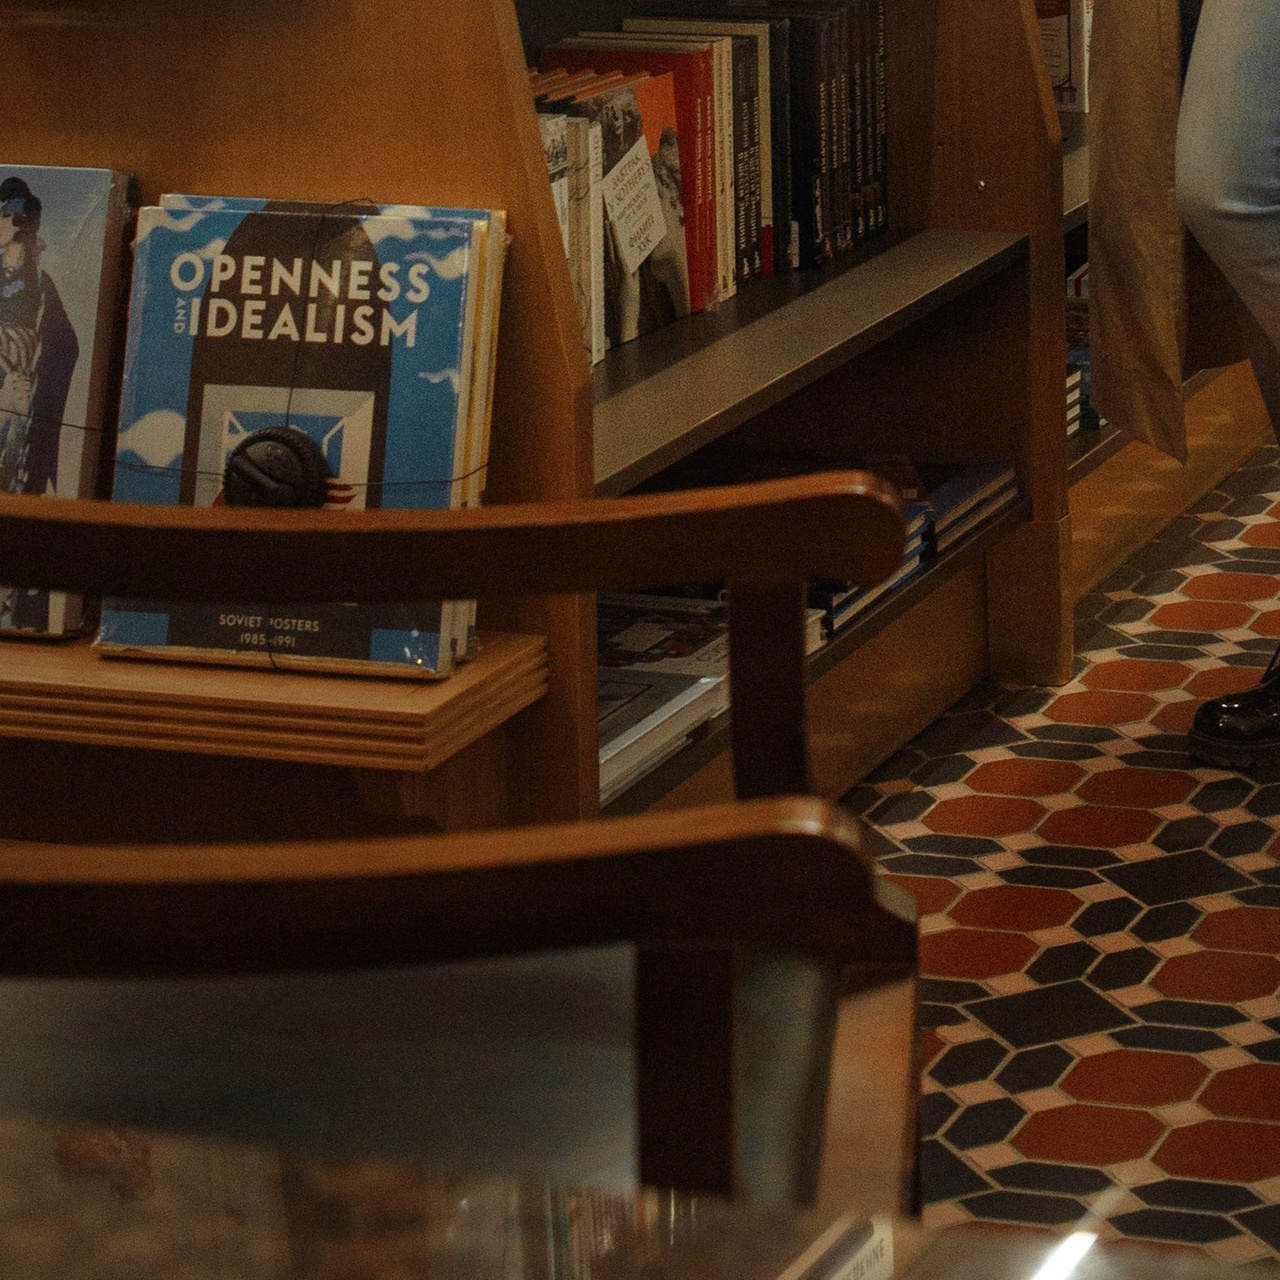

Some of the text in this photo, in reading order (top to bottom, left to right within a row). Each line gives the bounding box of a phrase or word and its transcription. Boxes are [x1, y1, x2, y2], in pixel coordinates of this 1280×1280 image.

[170, 251, 432, 304] OPENNESS
[174, 297, 185, 335] AND
[189, 297, 418, 348] IDEALISM
[219, 612, 321, 633] SOVIET POSTERS
